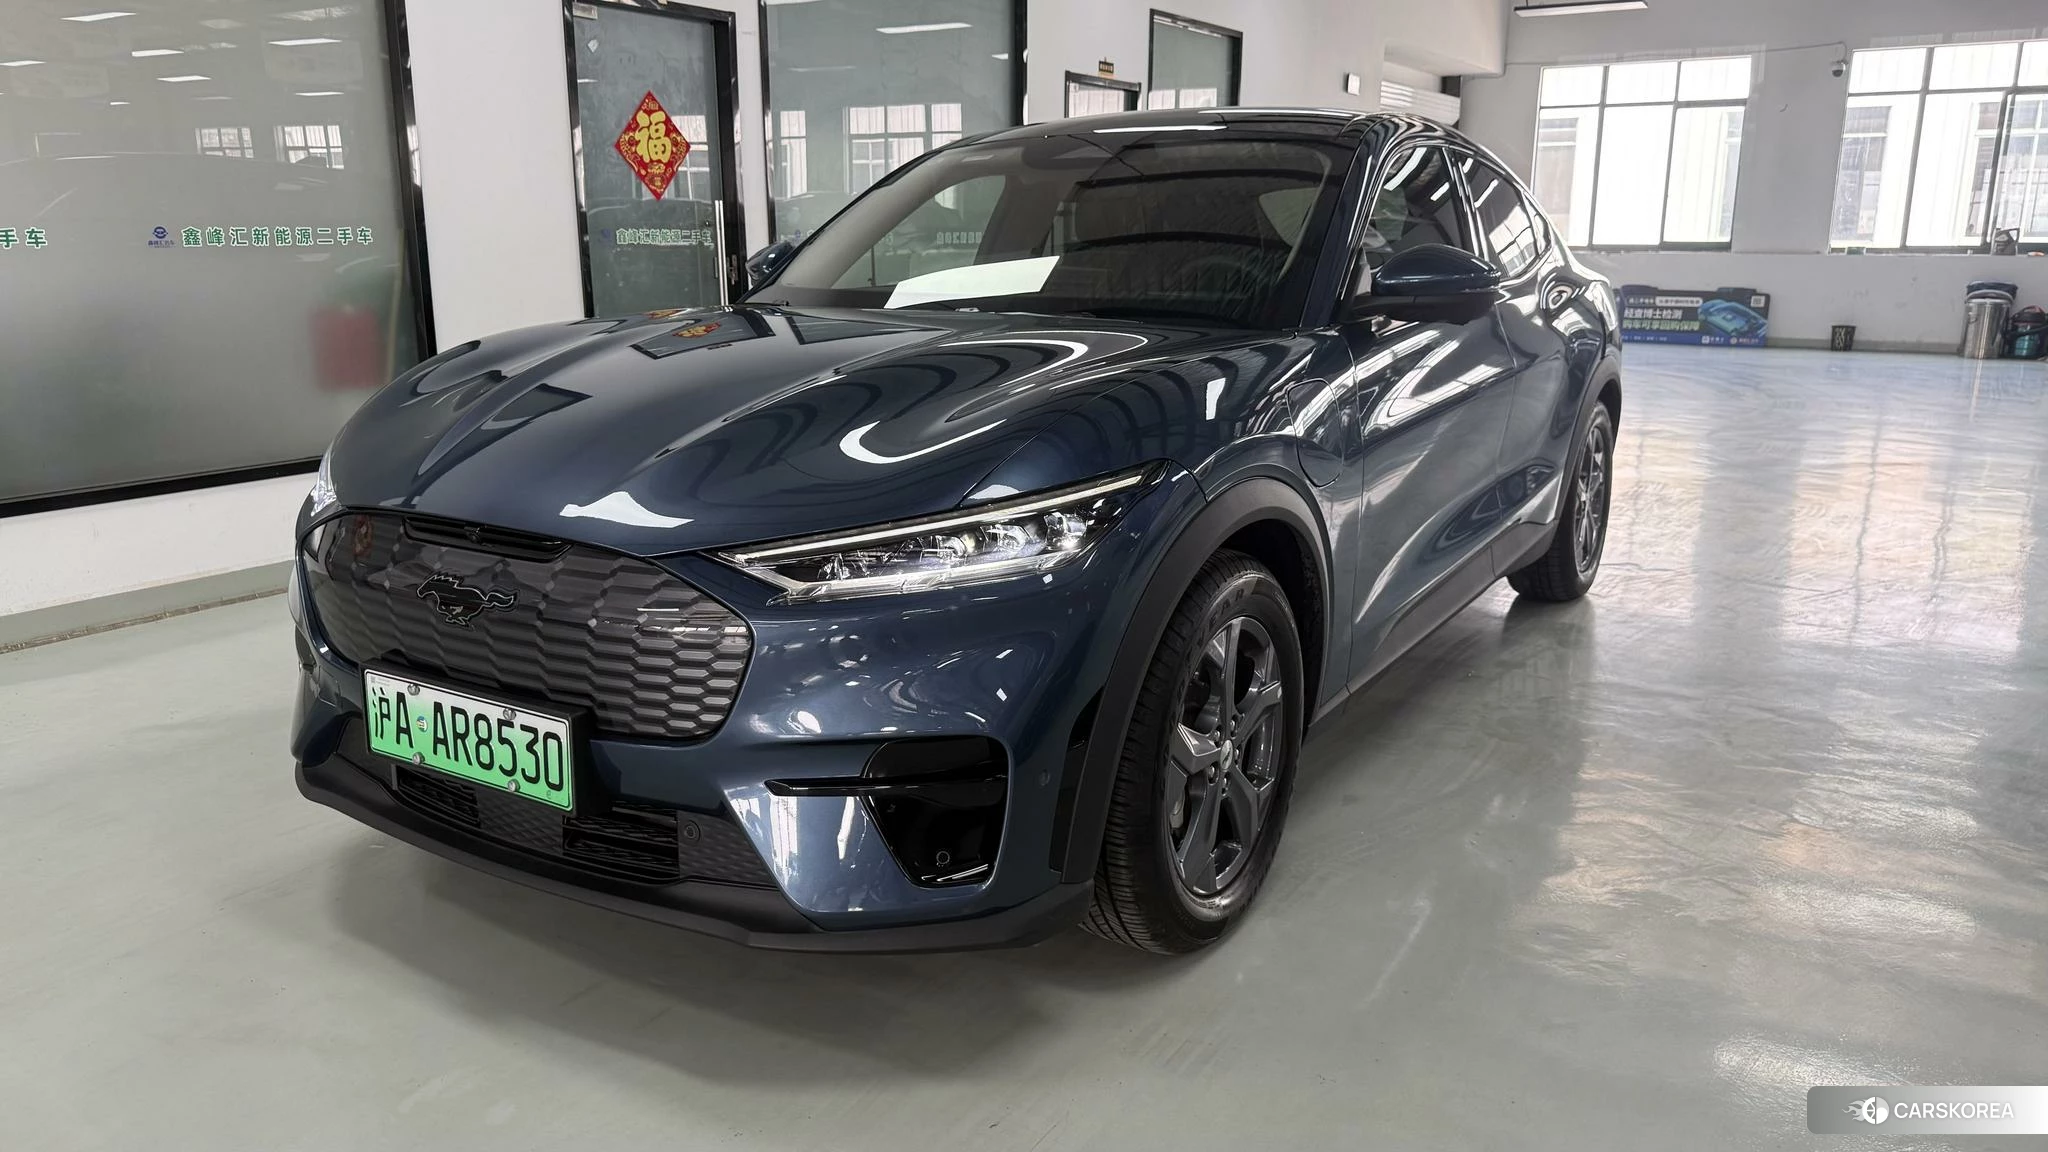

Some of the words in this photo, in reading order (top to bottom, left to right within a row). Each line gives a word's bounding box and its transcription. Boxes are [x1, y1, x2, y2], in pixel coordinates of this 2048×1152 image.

[635, 110, 672, 163] 福
[181, 226, 374, 248] 鑫峰汇新能源二手车
[372, 686, 414, 749] 沪A
[433, 701, 563, 792] AR8530
